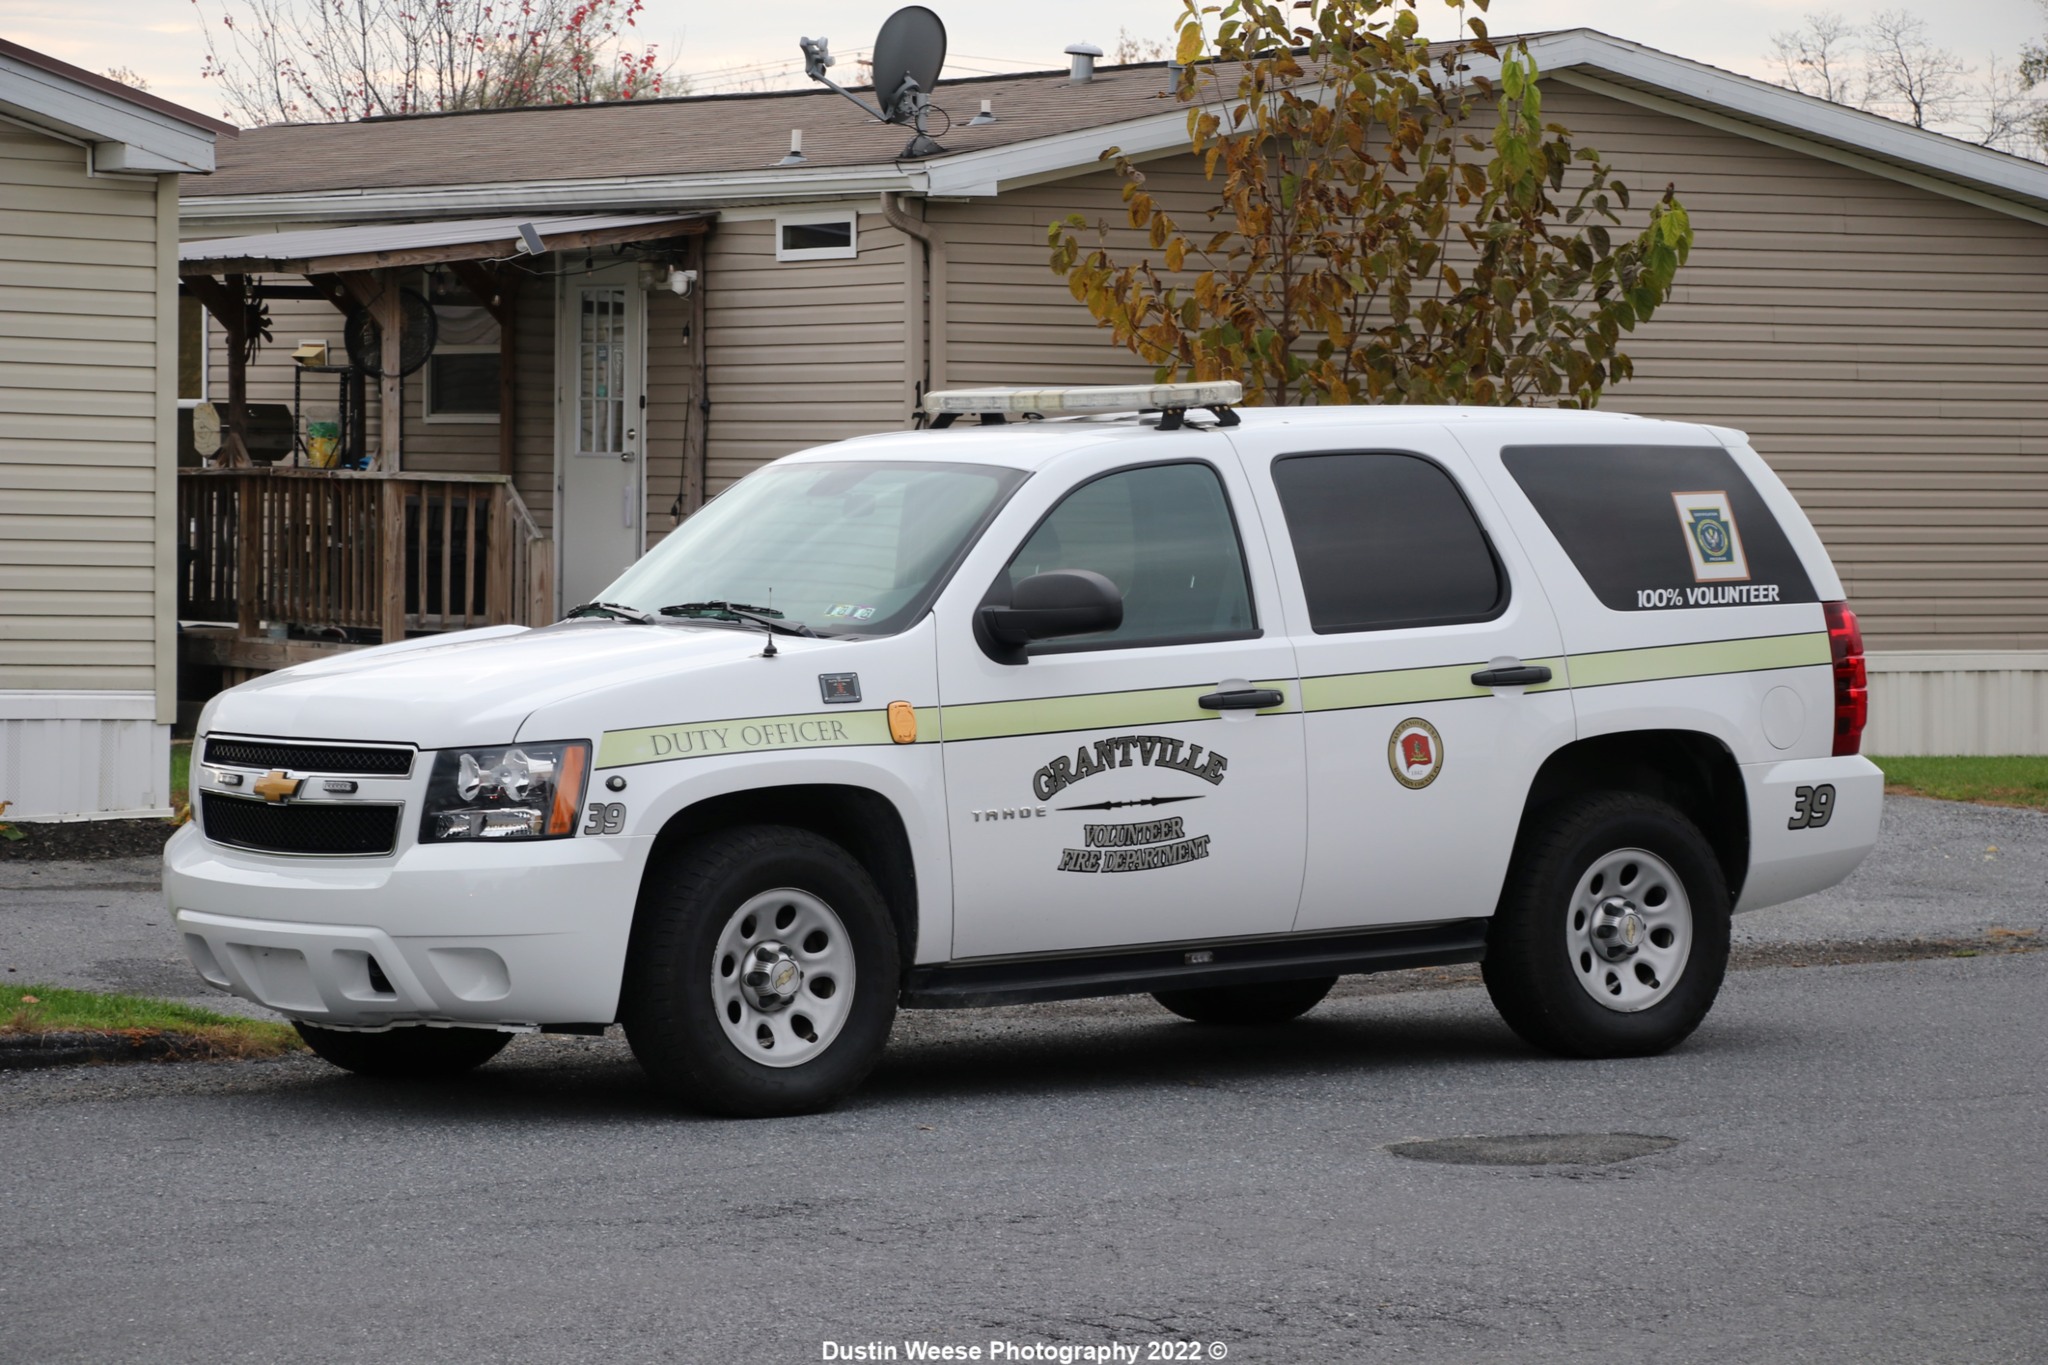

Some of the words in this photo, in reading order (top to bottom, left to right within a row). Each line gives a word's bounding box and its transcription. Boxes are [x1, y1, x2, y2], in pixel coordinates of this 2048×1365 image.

[1637, 588, 1683, 608] 100%
[1686, 584, 1780, 605] VOLUNTEER
[650, 728, 729, 756] DUTY
[742, 720, 848, 747] OFFICER
[1402, 720, 1428, 730] HANOVER
[1033, 735, 1228, 801] GRANTVILLE
[584, 802, 627, 836] 39
[971, 805, 1047, 822] TAHOE
[1787, 783, 1836, 830] 39
[1084, 816, 1185, 847] VOLUNTEER
[1057, 848, 1101, 873] FIRE
[1101, 834, 1211, 873] DEPARTMENT
